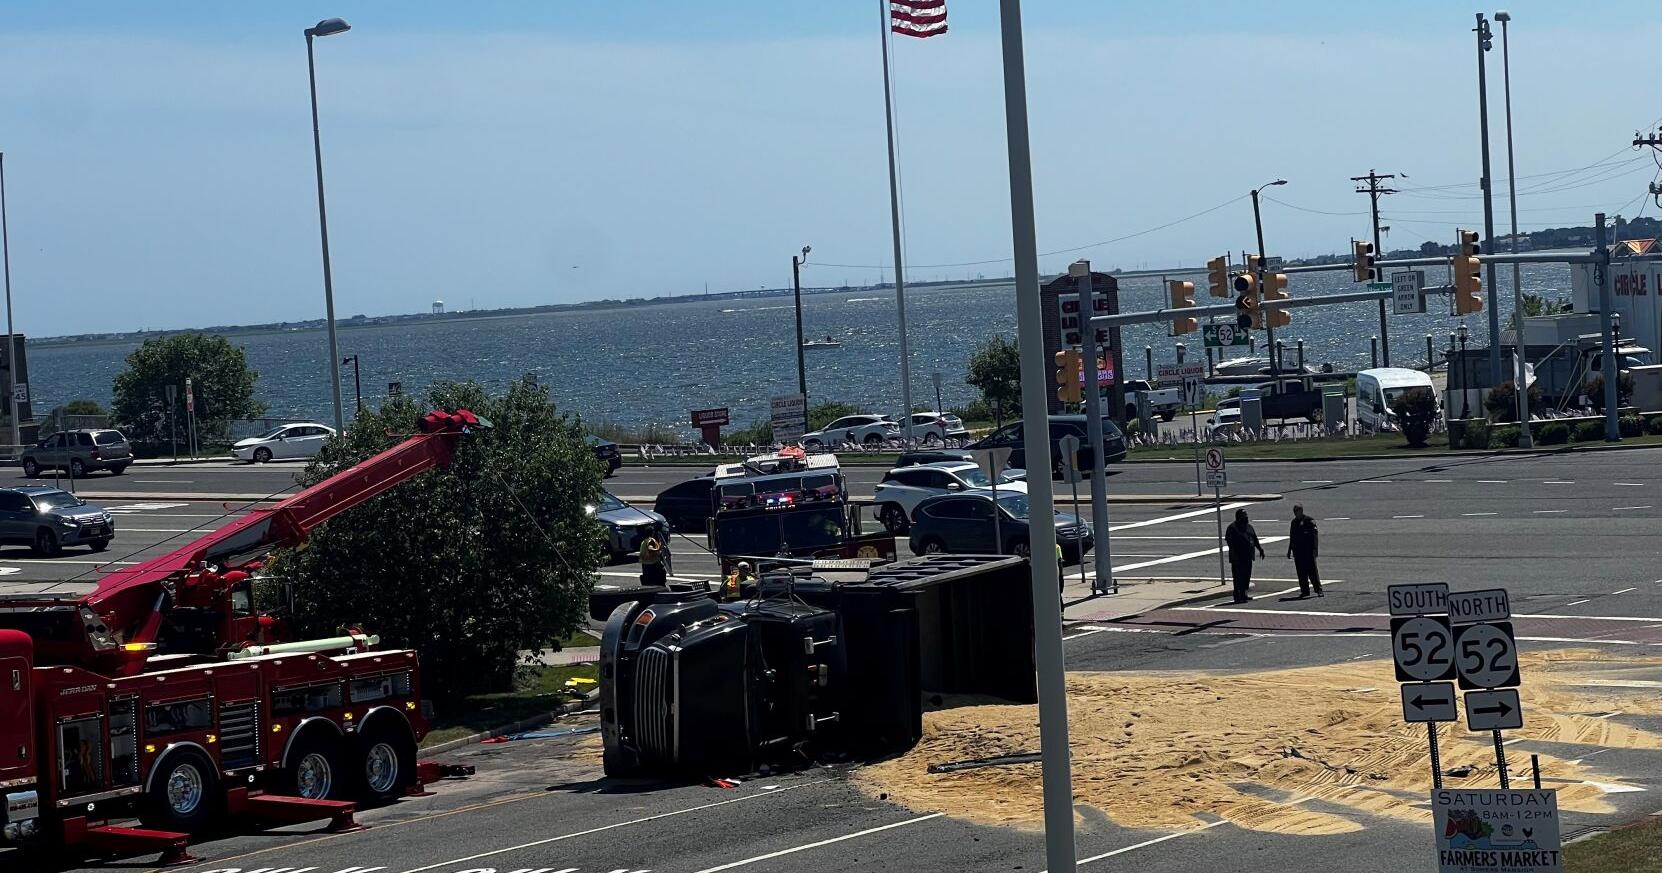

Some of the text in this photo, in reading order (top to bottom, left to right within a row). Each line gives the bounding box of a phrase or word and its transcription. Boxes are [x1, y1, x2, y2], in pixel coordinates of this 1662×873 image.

[1219, 329, 1232, 341] 52
[1158, 368, 1180, 376] CIRCLE
[1392, 590, 1447, 609] SOUTH
[1449, 596, 1507, 617] NORTH
[1401, 631, 1449, 666] 52
[1462, 637, 1511, 675] 52
[1438, 791, 1552, 806] SATURDAY
[1482, 810, 1553, 820] 8AM-12PM
[1440, 850, 1559, 867] FARMERS MARKET
